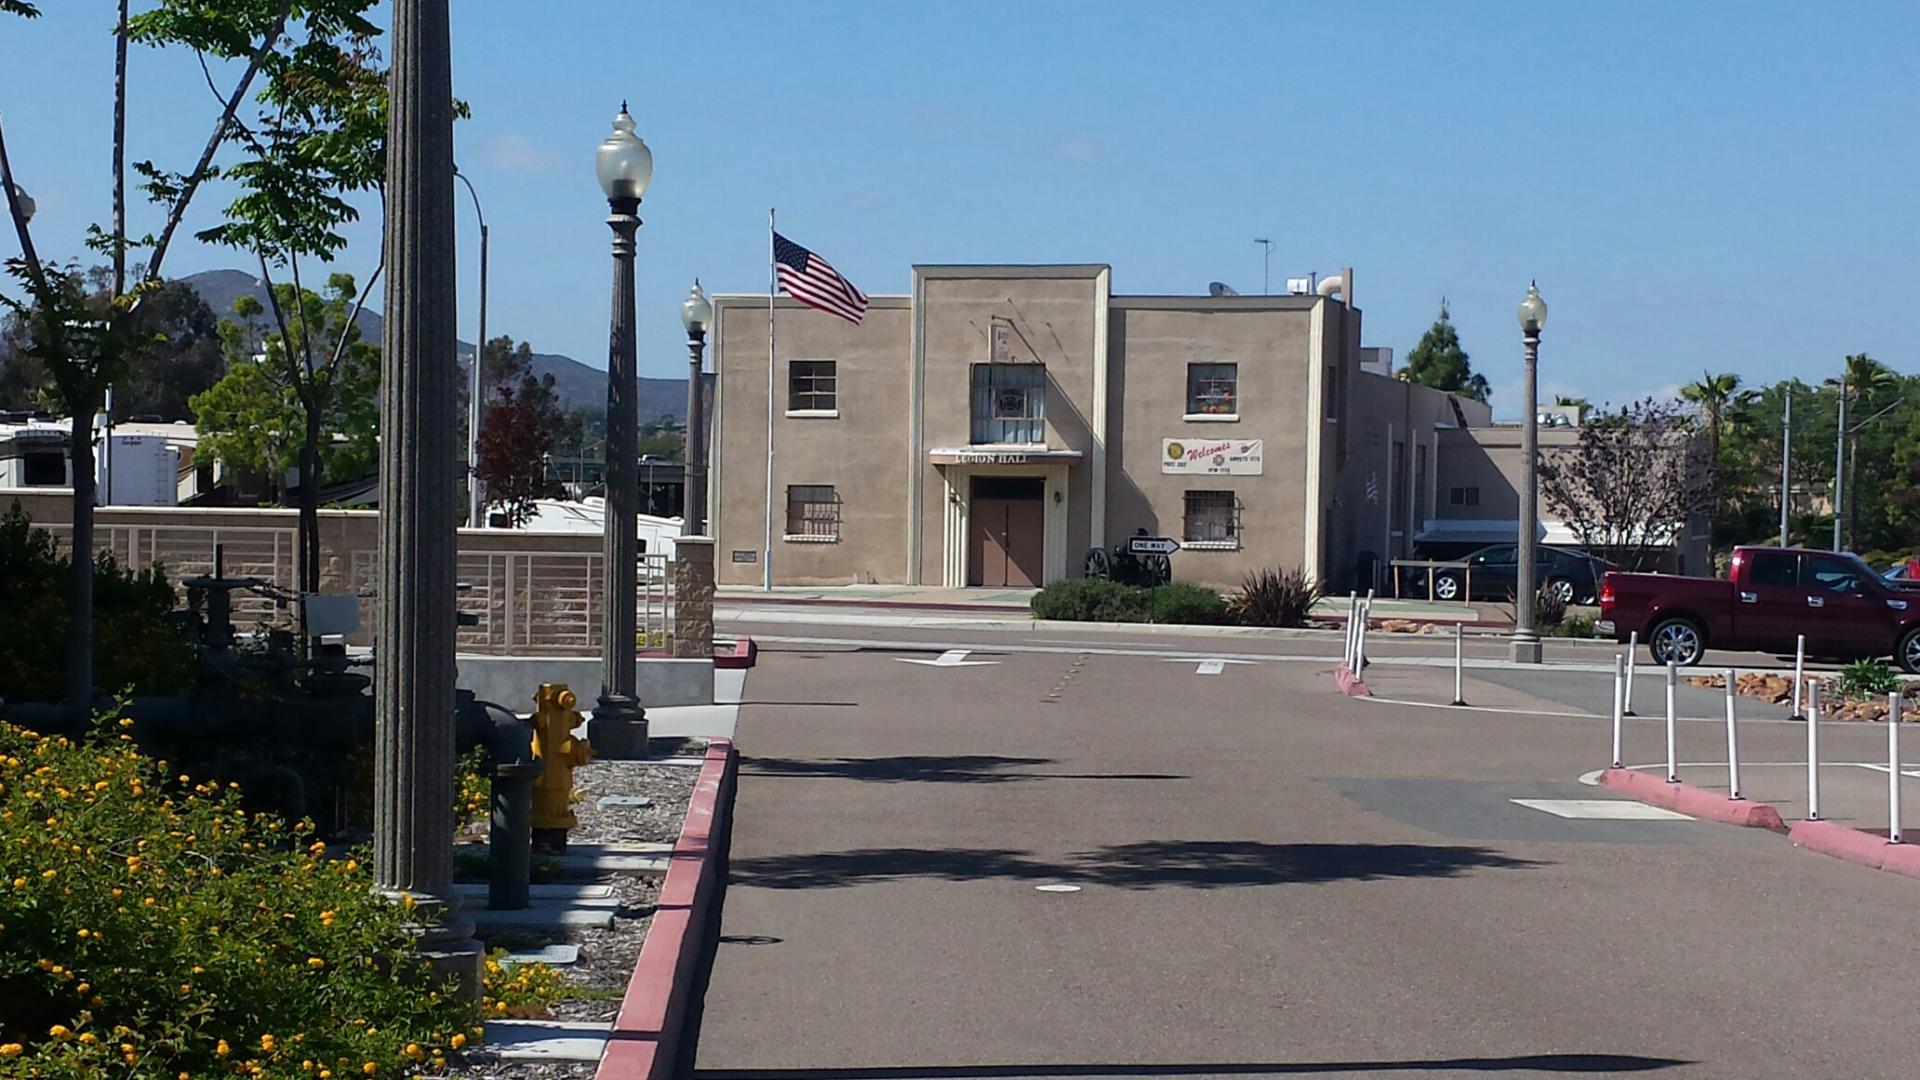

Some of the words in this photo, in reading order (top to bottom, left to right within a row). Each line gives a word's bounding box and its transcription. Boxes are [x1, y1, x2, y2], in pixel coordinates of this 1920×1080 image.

[1187, 442, 1231, 461] Welcomes
[955, 455, 995, 464] LEGION
[999, 455, 1028, 464] HALL
[1151, 542, 1165, 550] WAY
